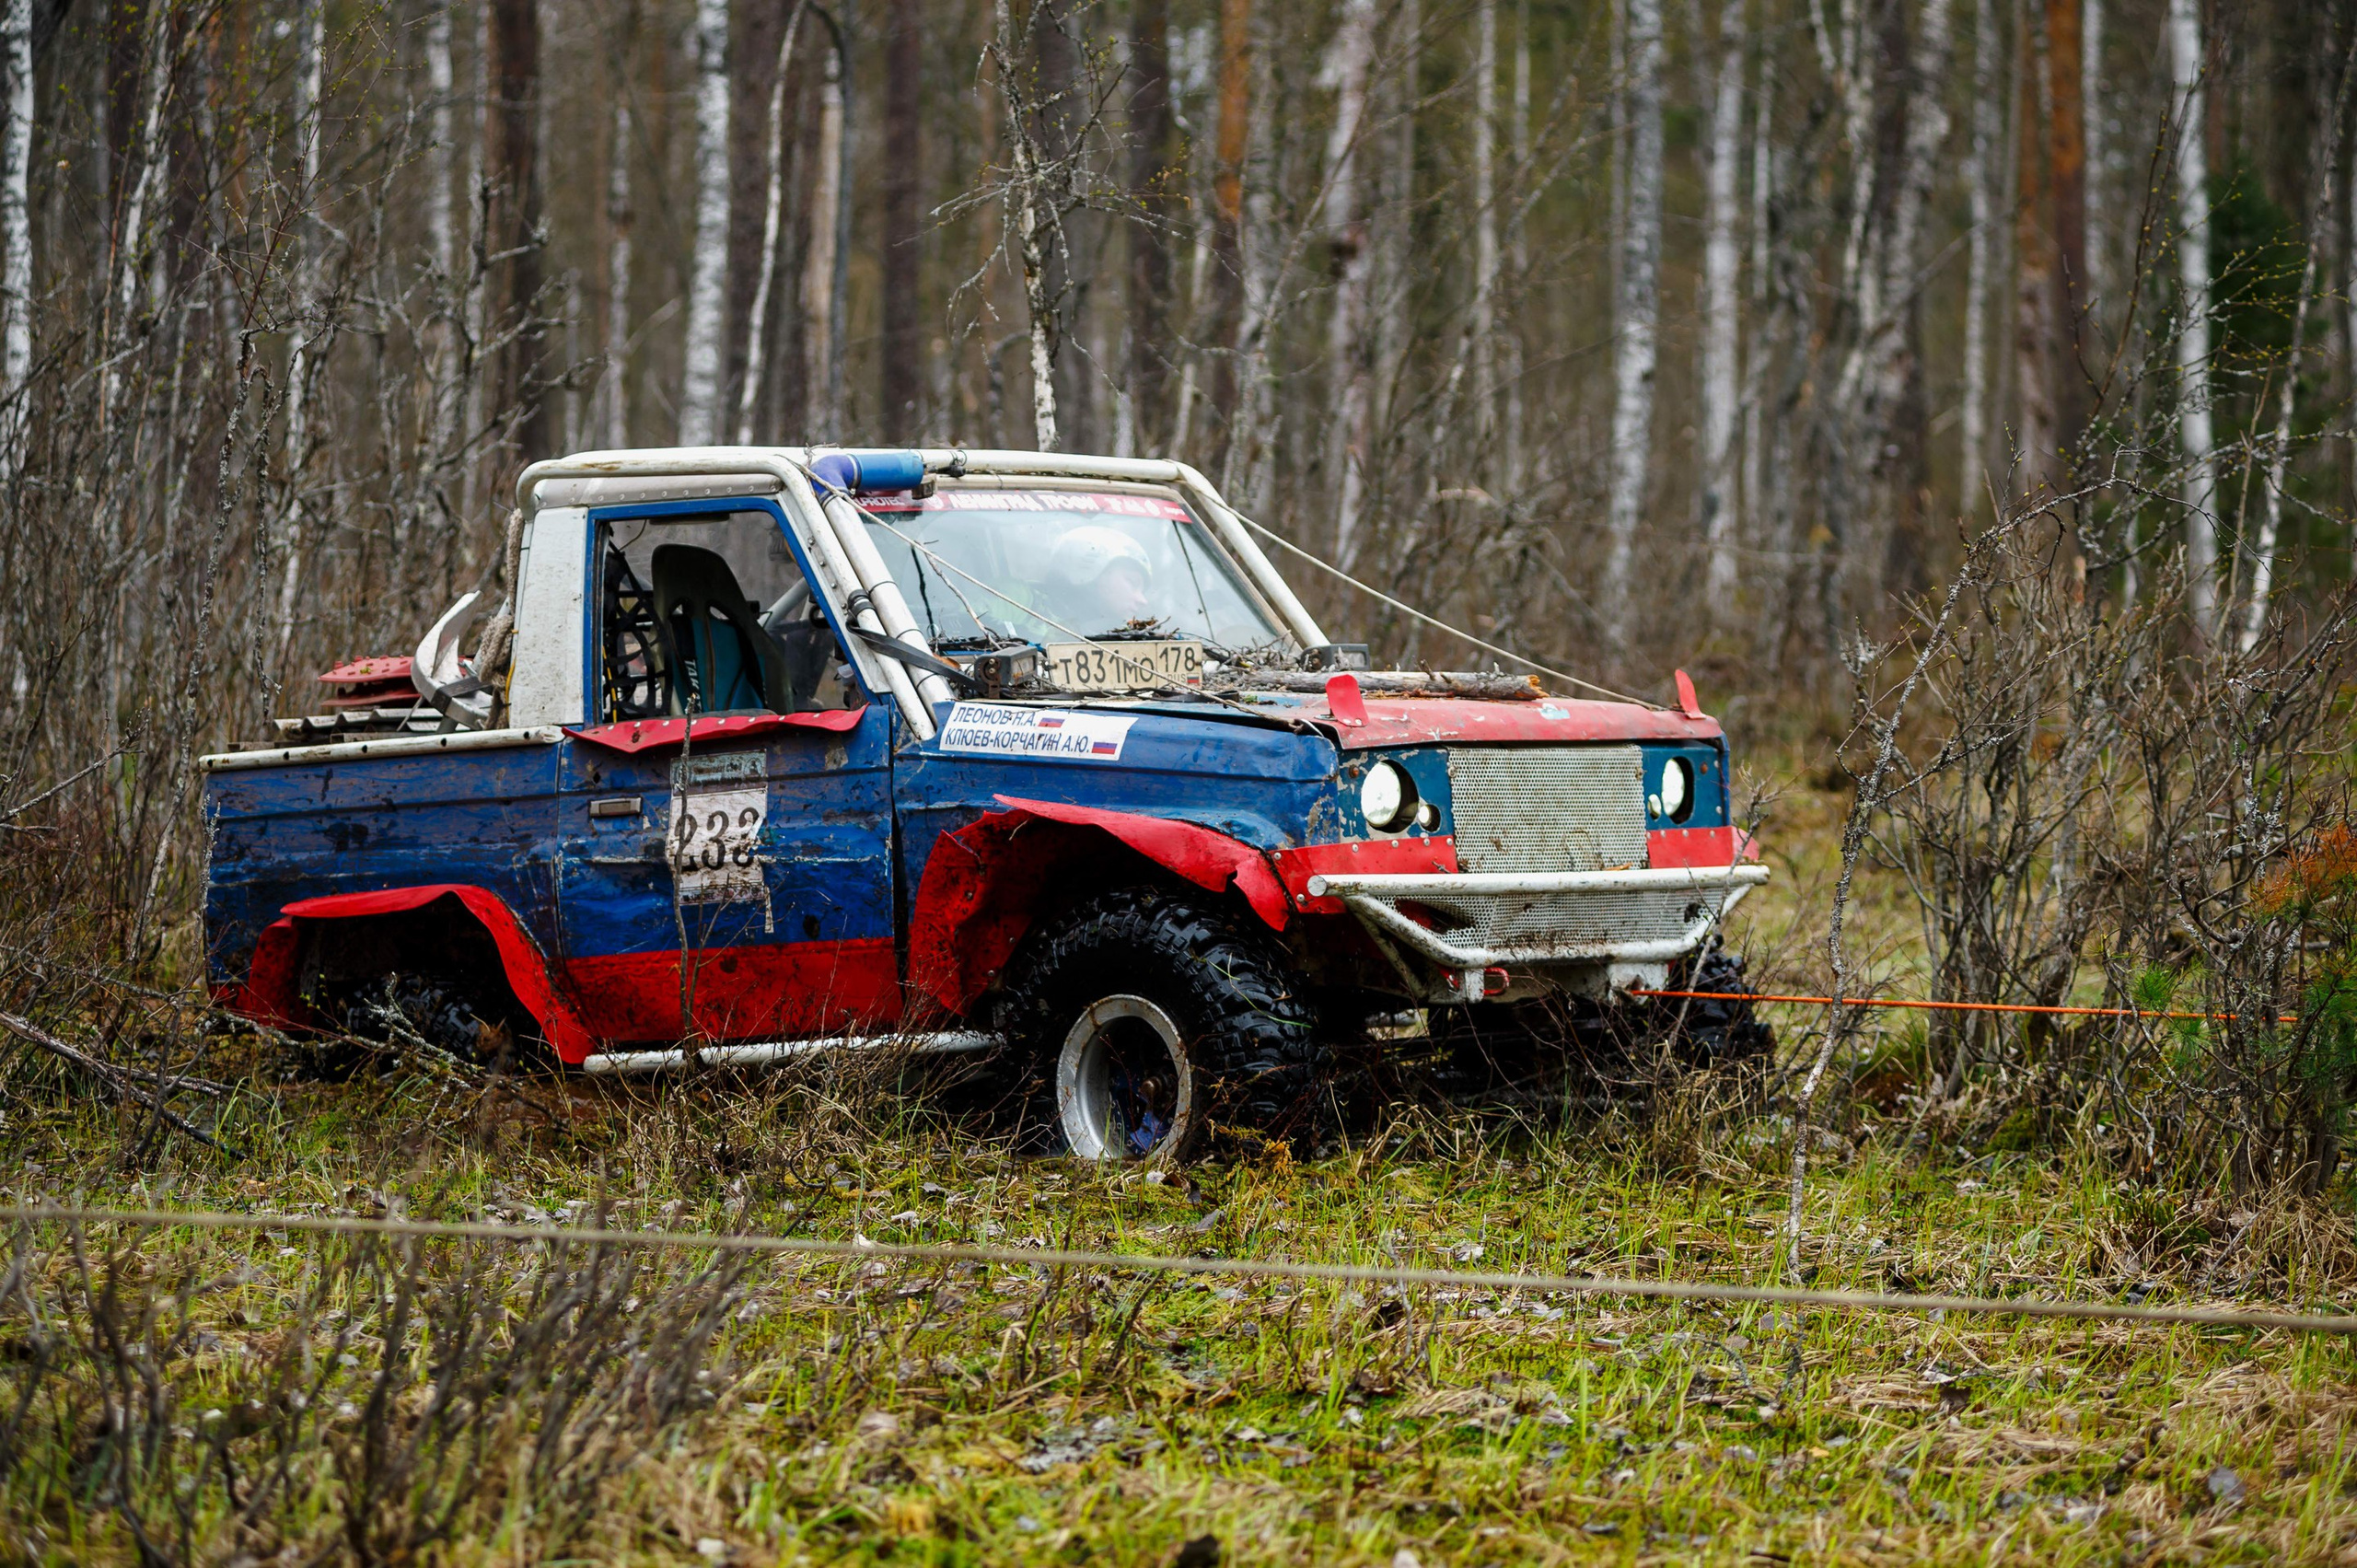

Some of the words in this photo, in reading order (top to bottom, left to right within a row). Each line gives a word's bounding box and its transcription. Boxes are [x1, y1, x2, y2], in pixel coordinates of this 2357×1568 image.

[1159, 646, 1195, 673] 178
[953, 706, 1010, 726] ЛЕОНОВ
[1012, 712, 1037, 727] Н.А.
[945, 728, 1060, 751] КЛЮЕВ-КОРЧАГИН
[1062, 735, 1090, 753] А.Ю.
